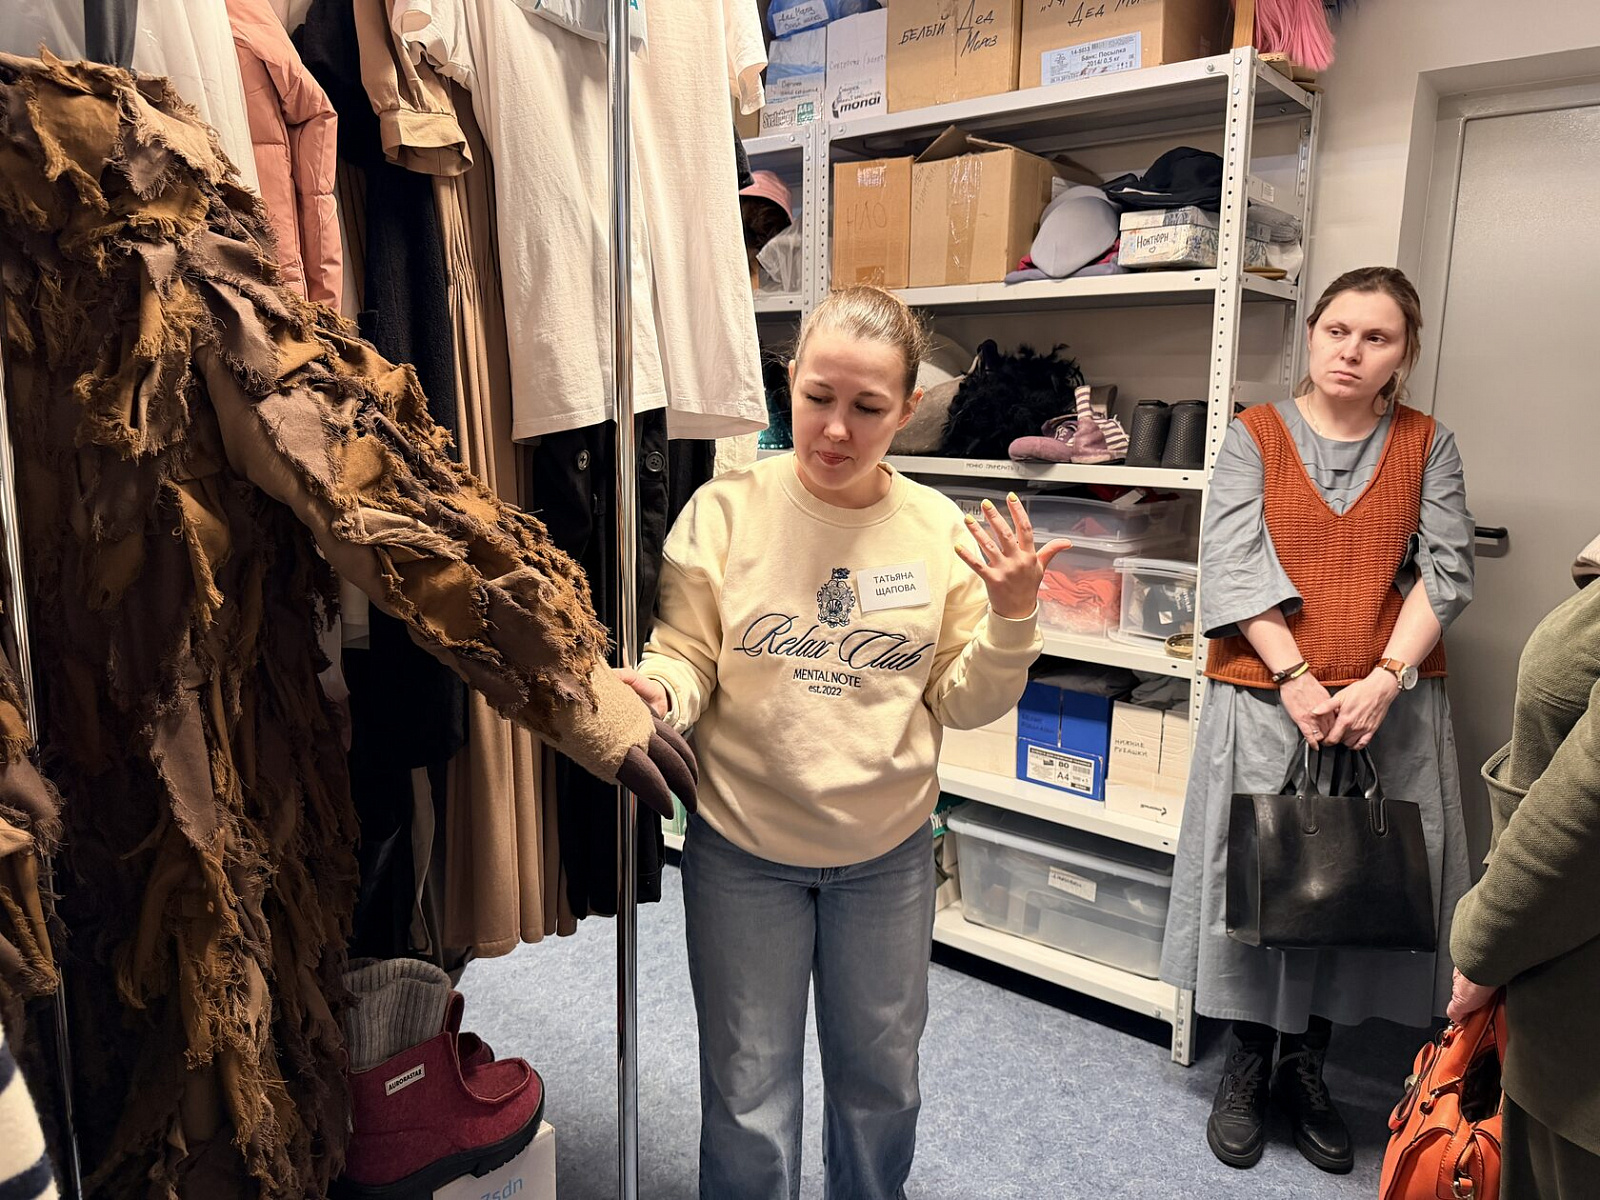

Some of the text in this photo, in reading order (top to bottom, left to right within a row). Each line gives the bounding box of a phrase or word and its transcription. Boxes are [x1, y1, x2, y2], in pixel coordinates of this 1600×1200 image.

[898, 12, 949, 45] БЕЛЫЙ
[1098, 47, 1127, 59] Посылка
[873, 571, 914, 584] ТАТЬЯНА
[875, 583, 917, 597] ЩАПОВА
[733, 613, 935, 671] Relax Club
